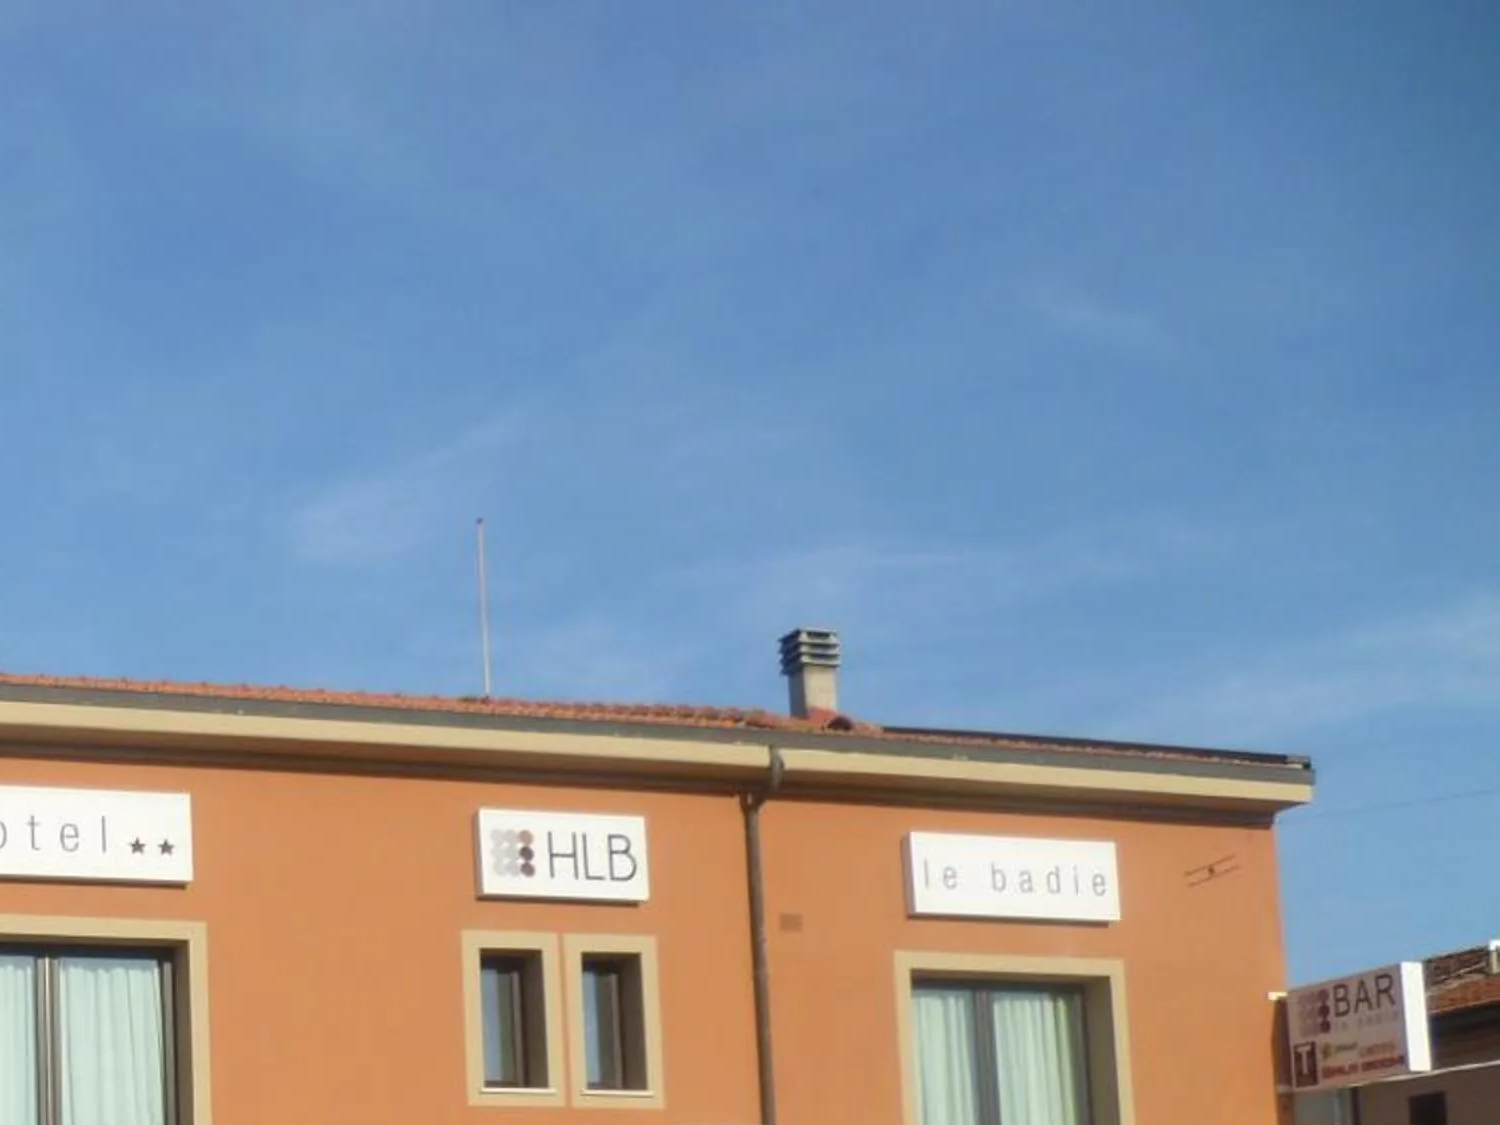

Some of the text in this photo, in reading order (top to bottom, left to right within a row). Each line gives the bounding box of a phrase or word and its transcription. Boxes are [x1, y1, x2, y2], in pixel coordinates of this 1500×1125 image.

[547, 830, 638, 882] HLB
[922, 856, 1108, 897] le badie
[1331, 973, 1397, 1018] BAR
